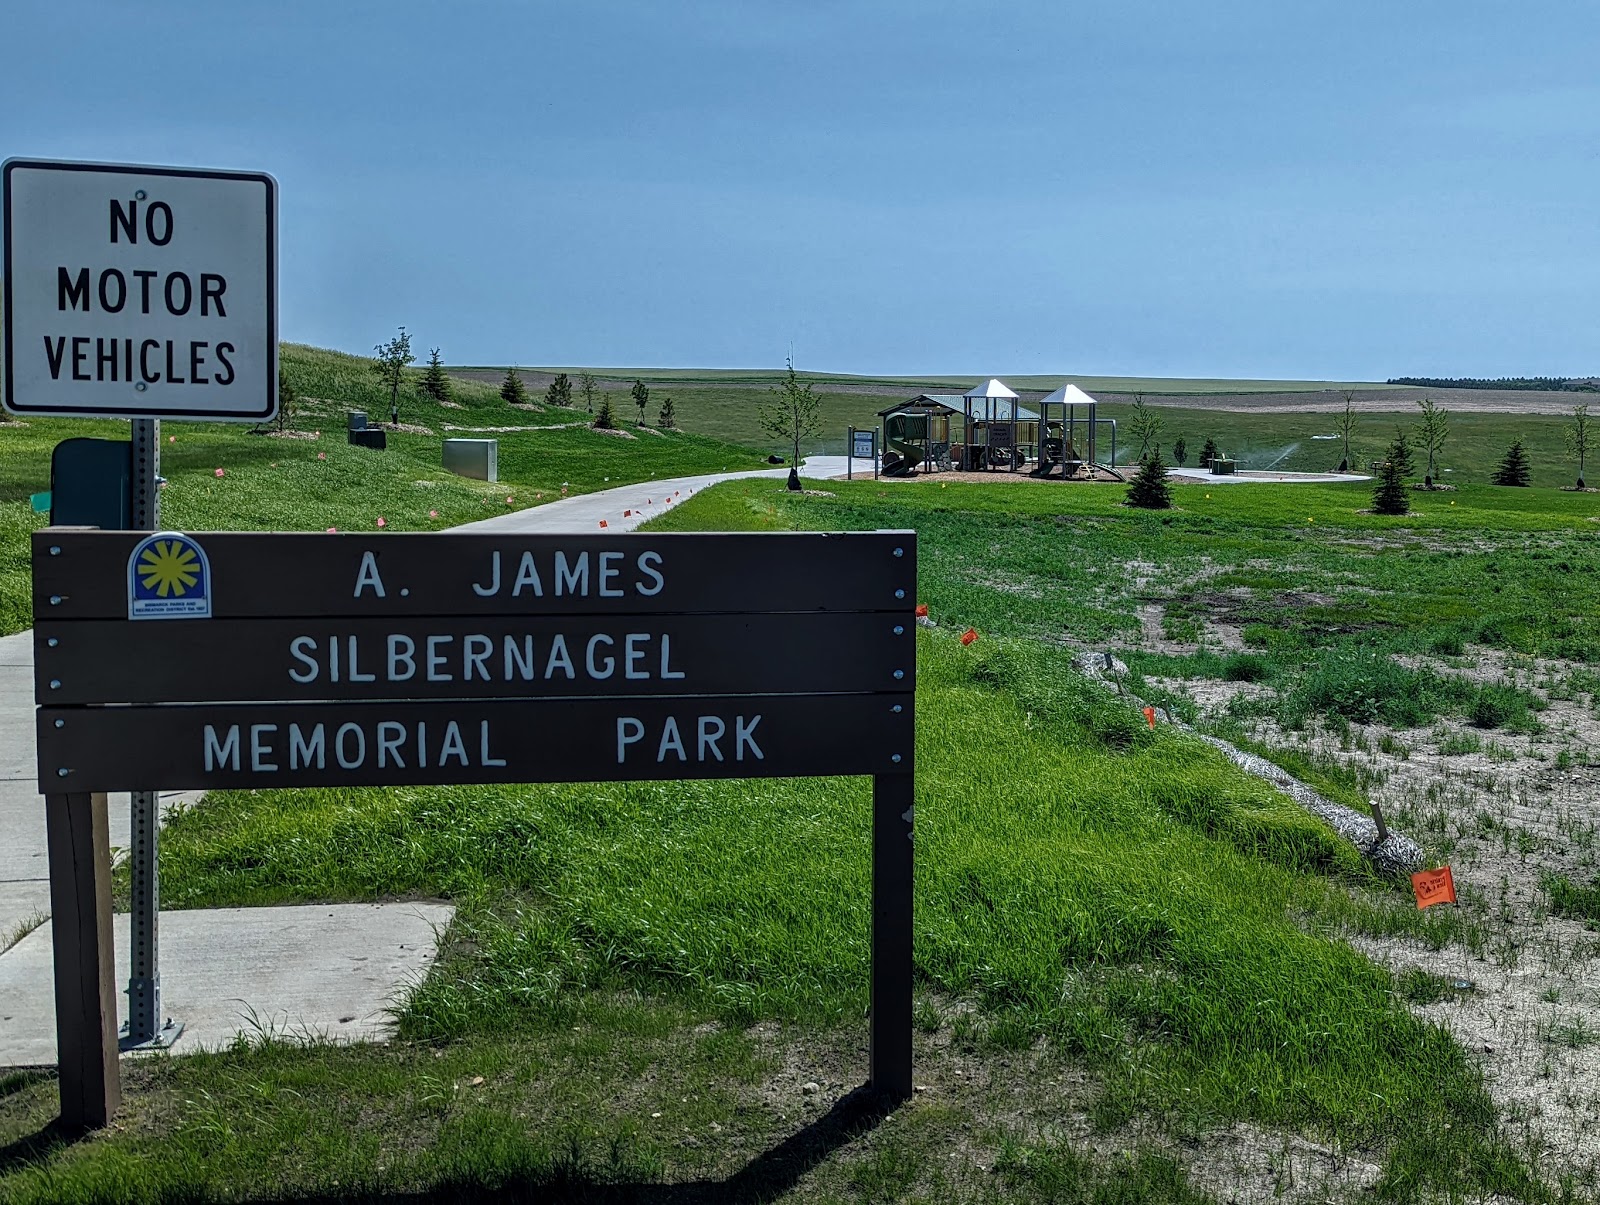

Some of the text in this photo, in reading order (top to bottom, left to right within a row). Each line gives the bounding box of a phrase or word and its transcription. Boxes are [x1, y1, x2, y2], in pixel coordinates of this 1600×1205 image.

[109, 199, 174, 247] NO
[57, 266, 227, 318] MOTOR
[43, 335, 235, 386] VEHICLES
[353, 551, 665, 598] A. JAMES
[289, 633, 686, 684] SILBERNAGEL
[204, 714, 764, 772] MEMORIAL PARK
